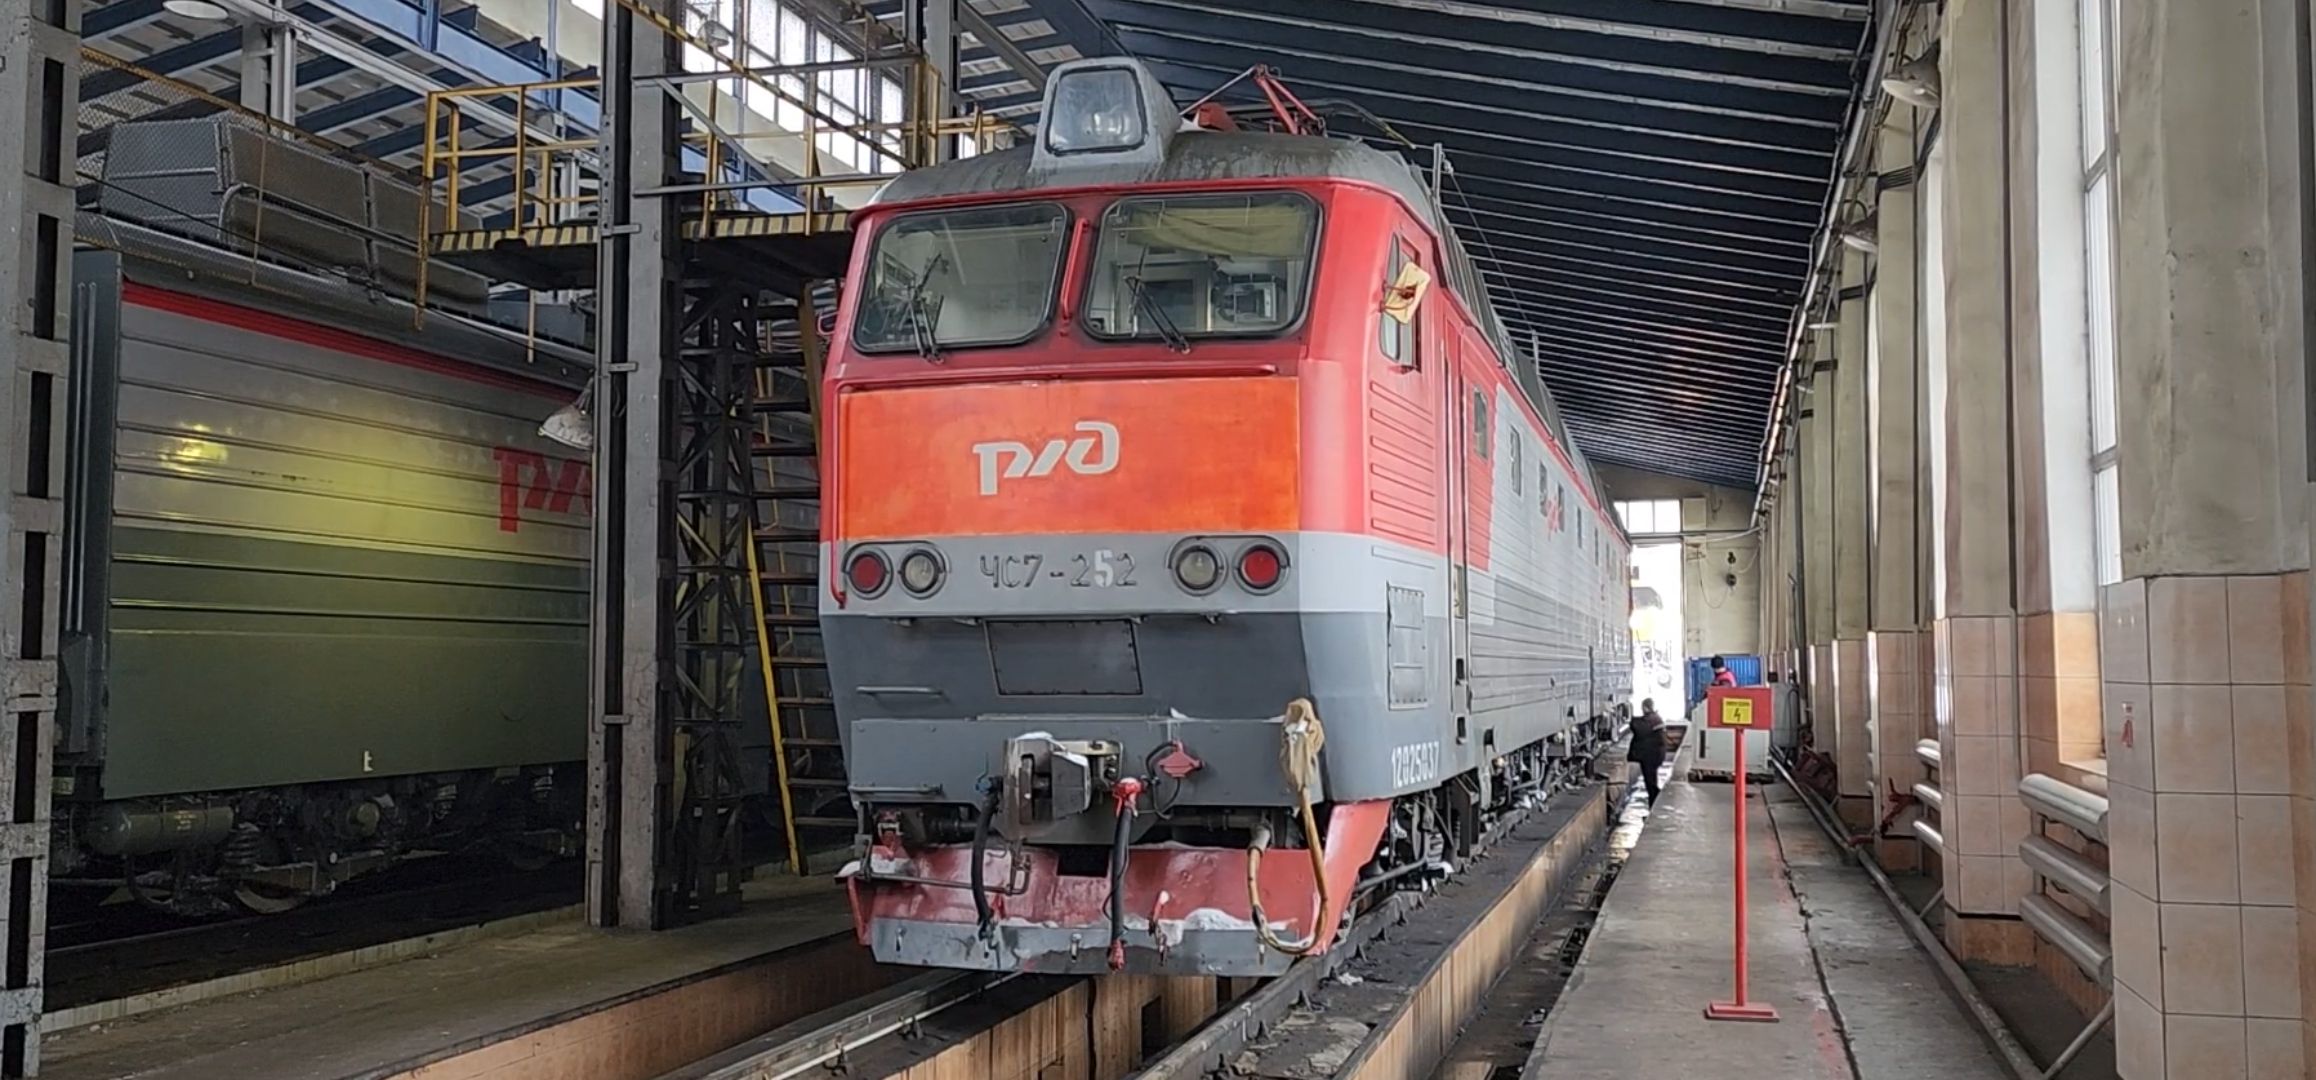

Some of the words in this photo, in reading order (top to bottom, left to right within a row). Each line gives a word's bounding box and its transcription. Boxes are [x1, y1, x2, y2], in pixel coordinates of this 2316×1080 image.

[972, 421, 1120, 495] РЖД
[979, 550, 1137, 588] ЧС7-252
[1391, 741, 1440, 789] 12025037
